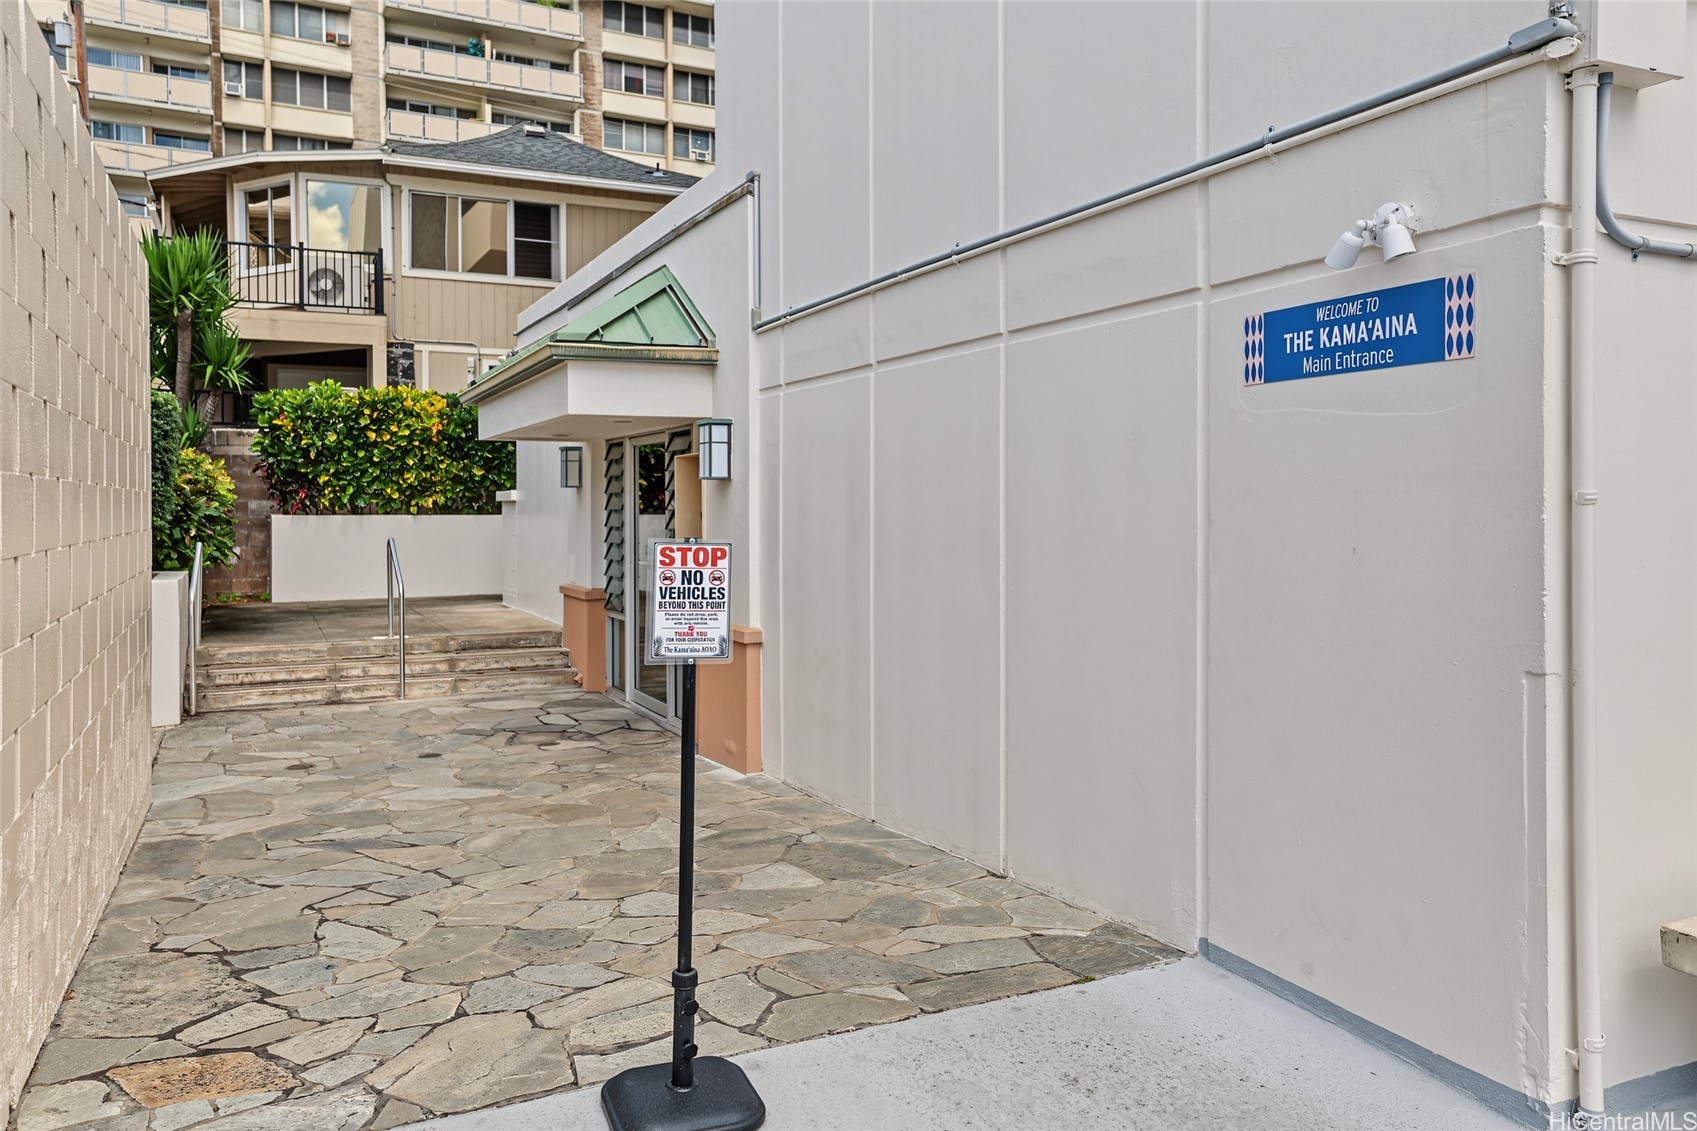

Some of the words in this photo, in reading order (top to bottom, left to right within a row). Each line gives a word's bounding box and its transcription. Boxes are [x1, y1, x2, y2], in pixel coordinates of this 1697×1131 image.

[1316, 300, 1363, 322] WELCOME
[1365, 297, 1379, 313] TO
[1283, 329, 1314, 354] THE
[1303, 354, 1331, 374] Main
[1335, 349, 1394, 370] Entrance
[659, 546, 727, 567] STOP
[681, 570, 704, 586] NO
[659, 586, 726, 600] VEHICLES
[658, 601, 686, 609] BEYOND
[688, 601, 704, 609] THIS
[705, 601, 726, 609] POINT
